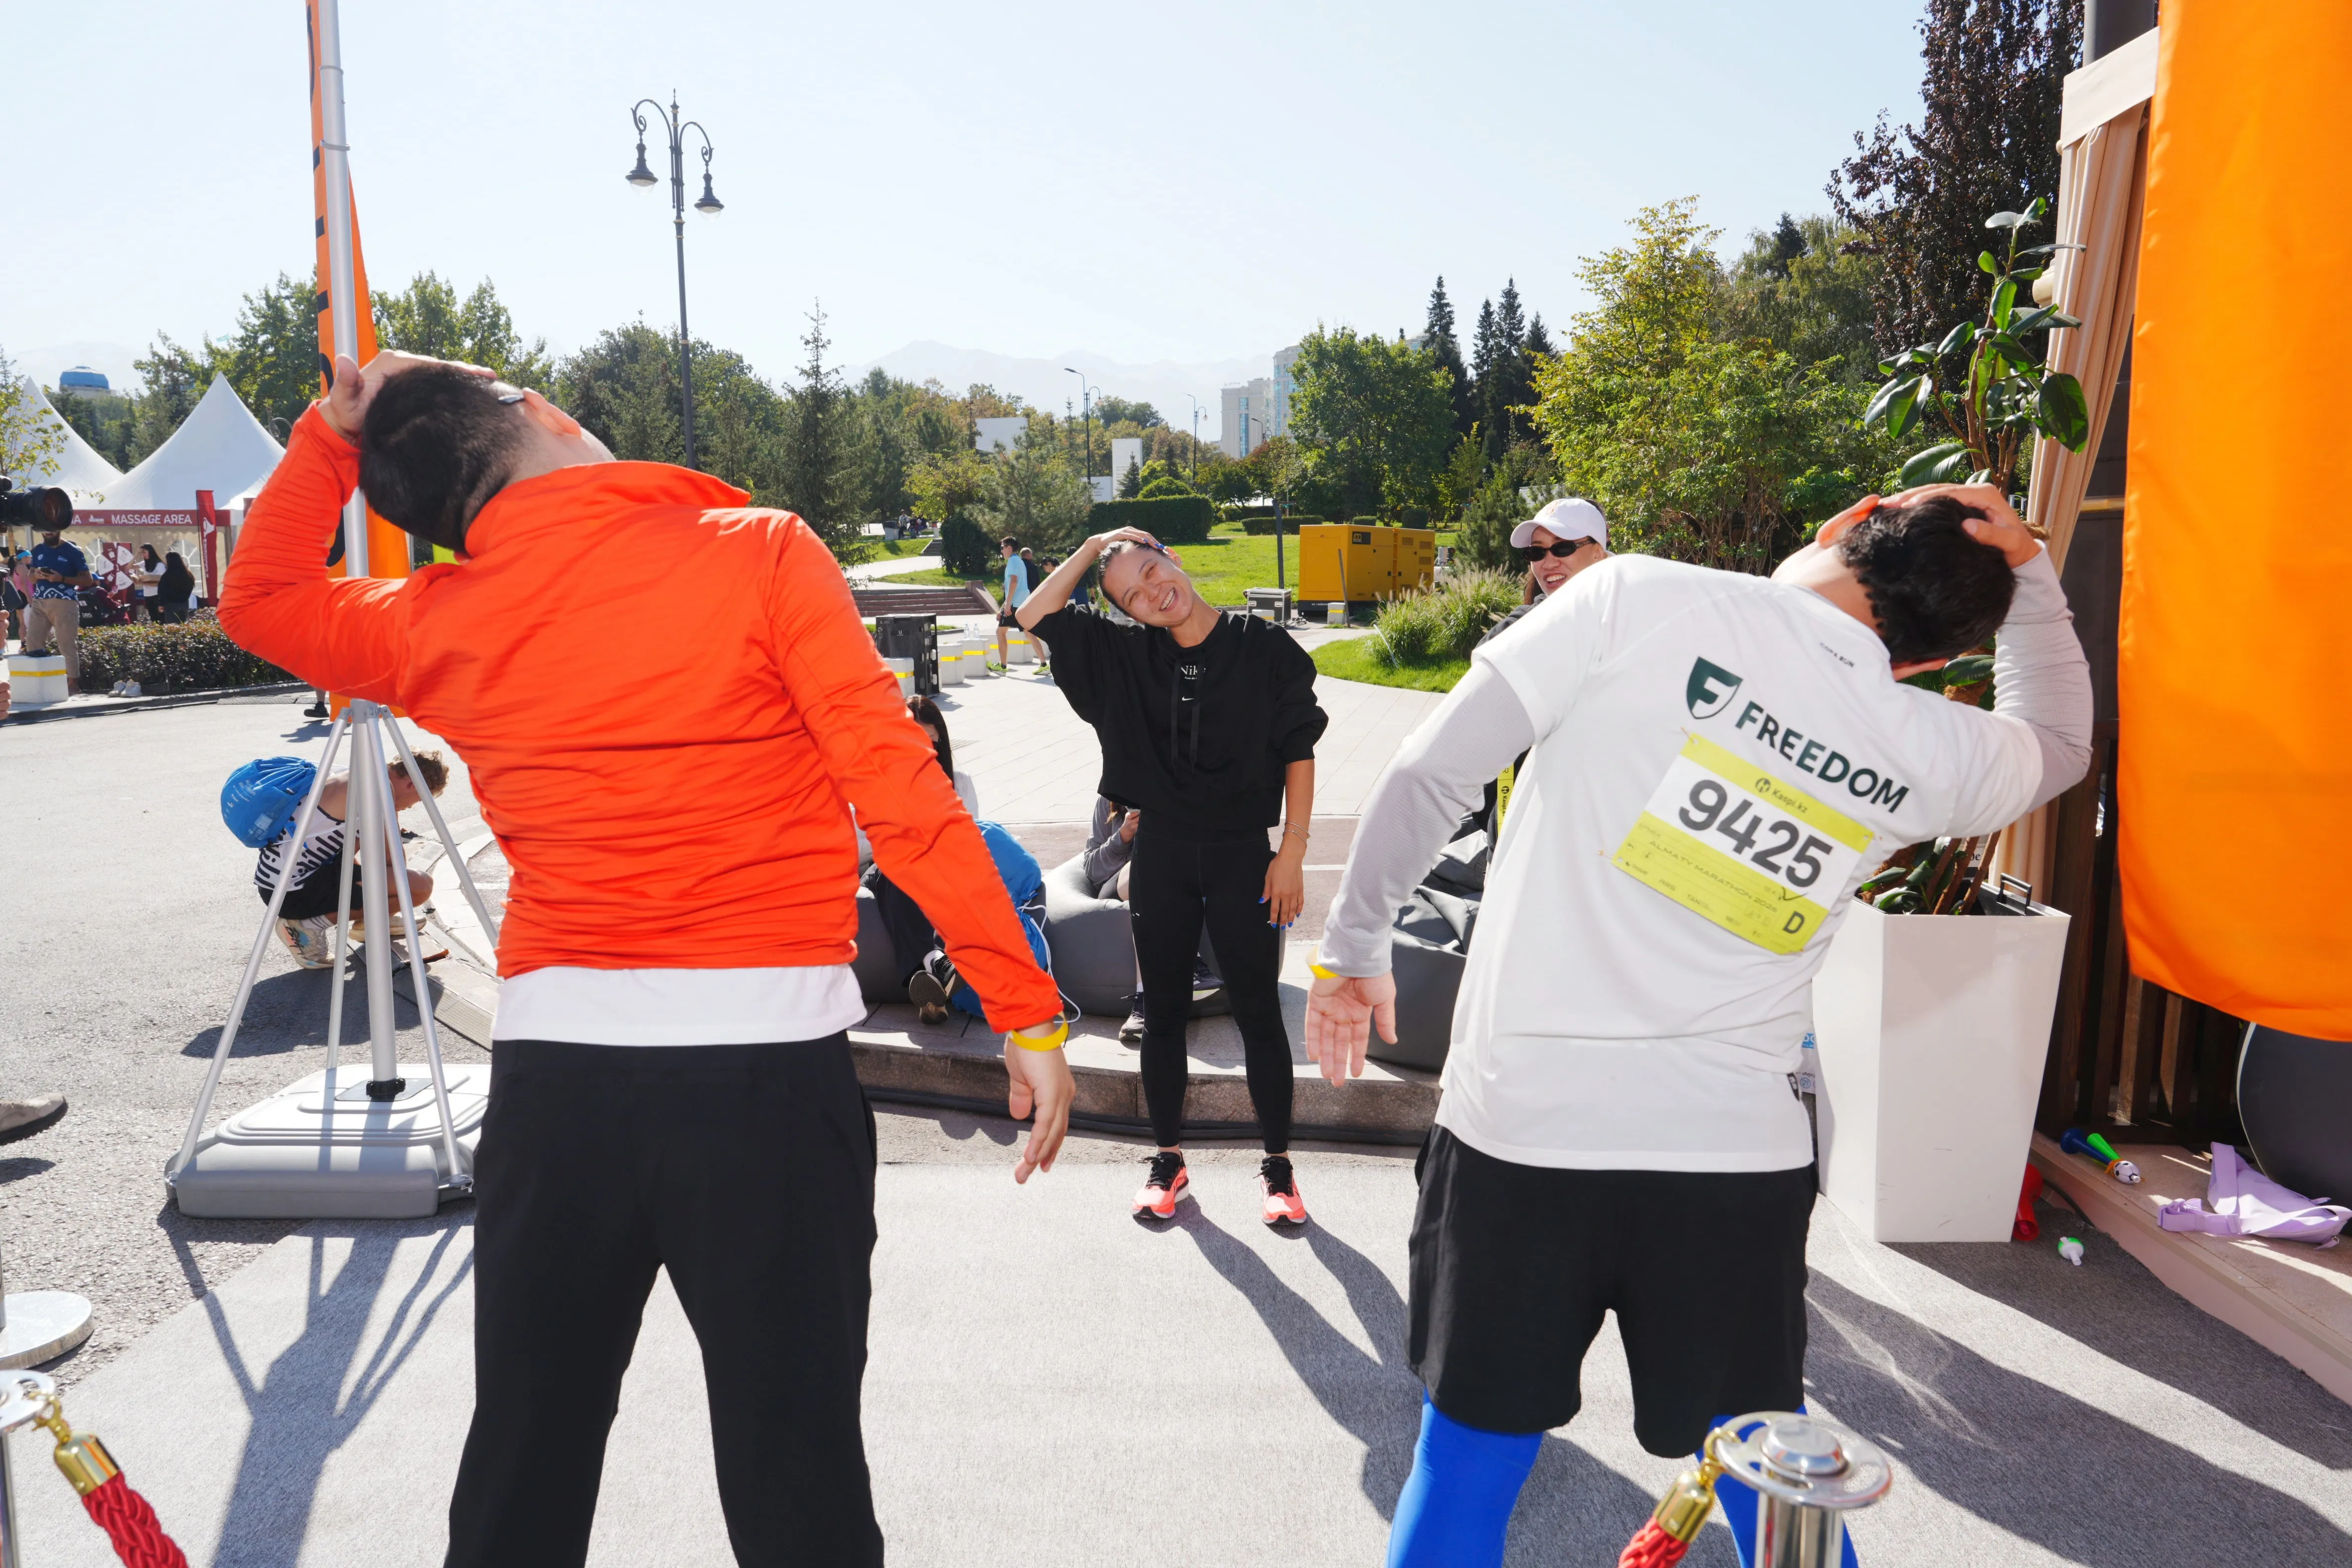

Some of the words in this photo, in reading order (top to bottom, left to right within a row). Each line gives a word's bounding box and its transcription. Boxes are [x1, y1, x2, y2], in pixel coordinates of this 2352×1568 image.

[111, 514, 161, 524] MASSAGE
[163, 514, 193, 524] AREA
[1735, 700, 1910, 814] FREEDOM
[1771, 788, 1808, 813] Kaspi.kz
[1679, 780, 1833, 887] 9425
[1649, 841, 1693, 865] ALMATY
[1694, 865, 1753, 899] MARATHON
[1782, 910, 1805, 934] D
